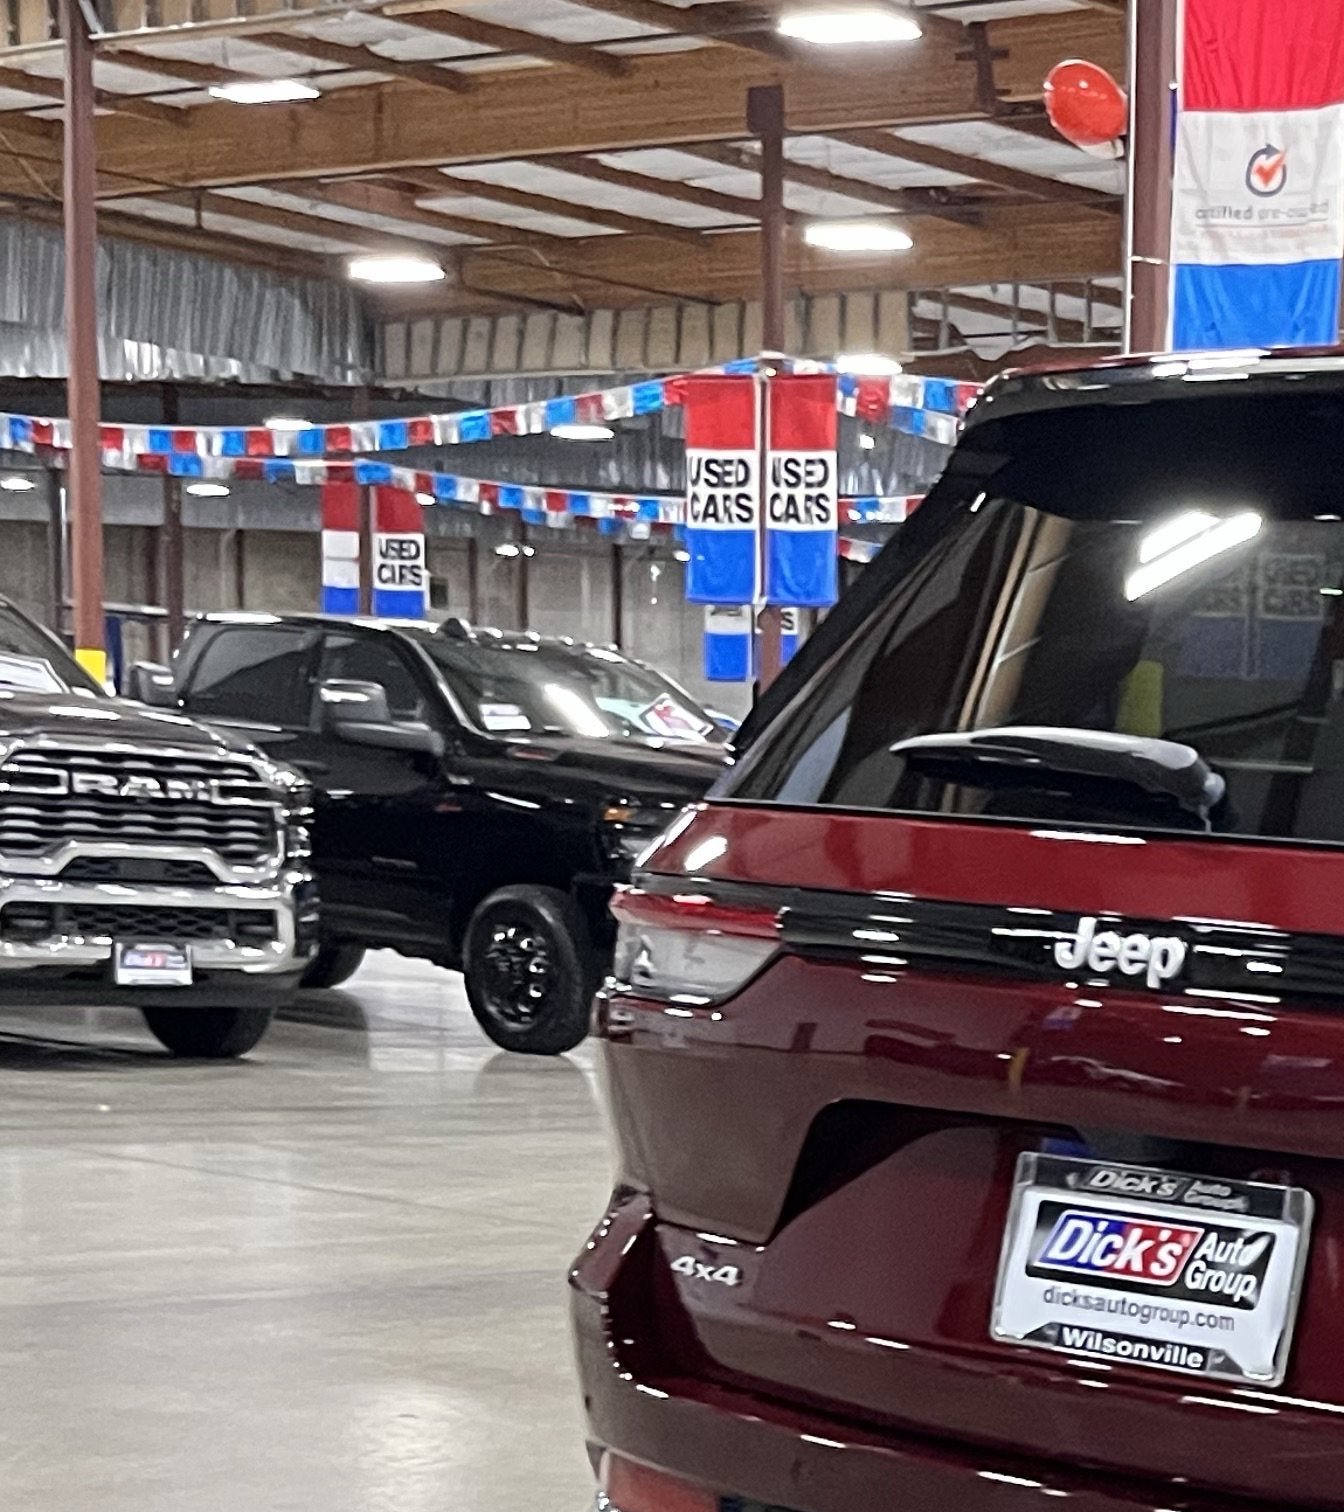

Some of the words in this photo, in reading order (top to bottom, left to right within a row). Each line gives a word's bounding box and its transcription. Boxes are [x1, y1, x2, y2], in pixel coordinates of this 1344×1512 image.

[690, 458, 750, 488] USED
[772, 458, 829, 488] USED
[690, 493, 754, 523] CARS
[770, 493, 831, 523] CARS
[1054, 916, 1188, 989] Jeep
[1048, 1218, 1184, 1277] Dick's
[1193, 1231, 1258, 1267] Auto
[670, 1255, 739, 1286] 4x4
[1184, 1259, 1258, 1303] Group
[1043, 1284, 1236, 1331] dicksautogroup.com
[1061, 1326, 1205, 1369] Wilsonville
